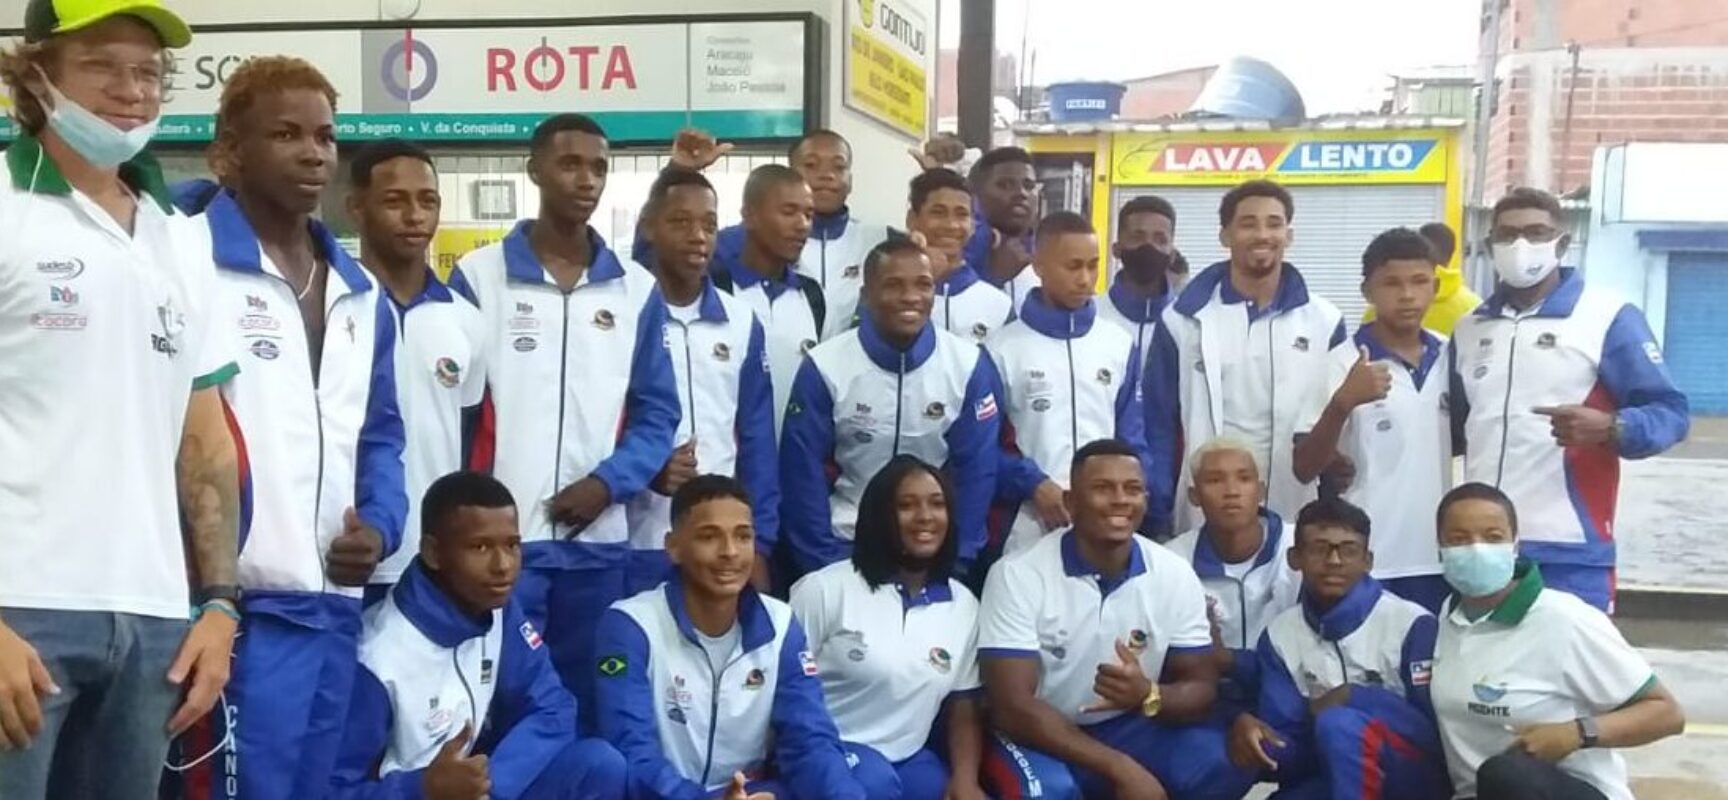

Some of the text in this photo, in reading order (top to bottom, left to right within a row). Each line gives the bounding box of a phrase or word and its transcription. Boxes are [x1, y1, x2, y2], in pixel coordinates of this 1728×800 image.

[486, 41, 638, 92] ROTA
[359, 121, 401, 136] Seguro
[435, 122, 450, 133] da
[453, 121, 516, 135] Conquista
[1165, 144, 1414, 171] LAVA LENTO
[224, 704, 239, 800] CANO
